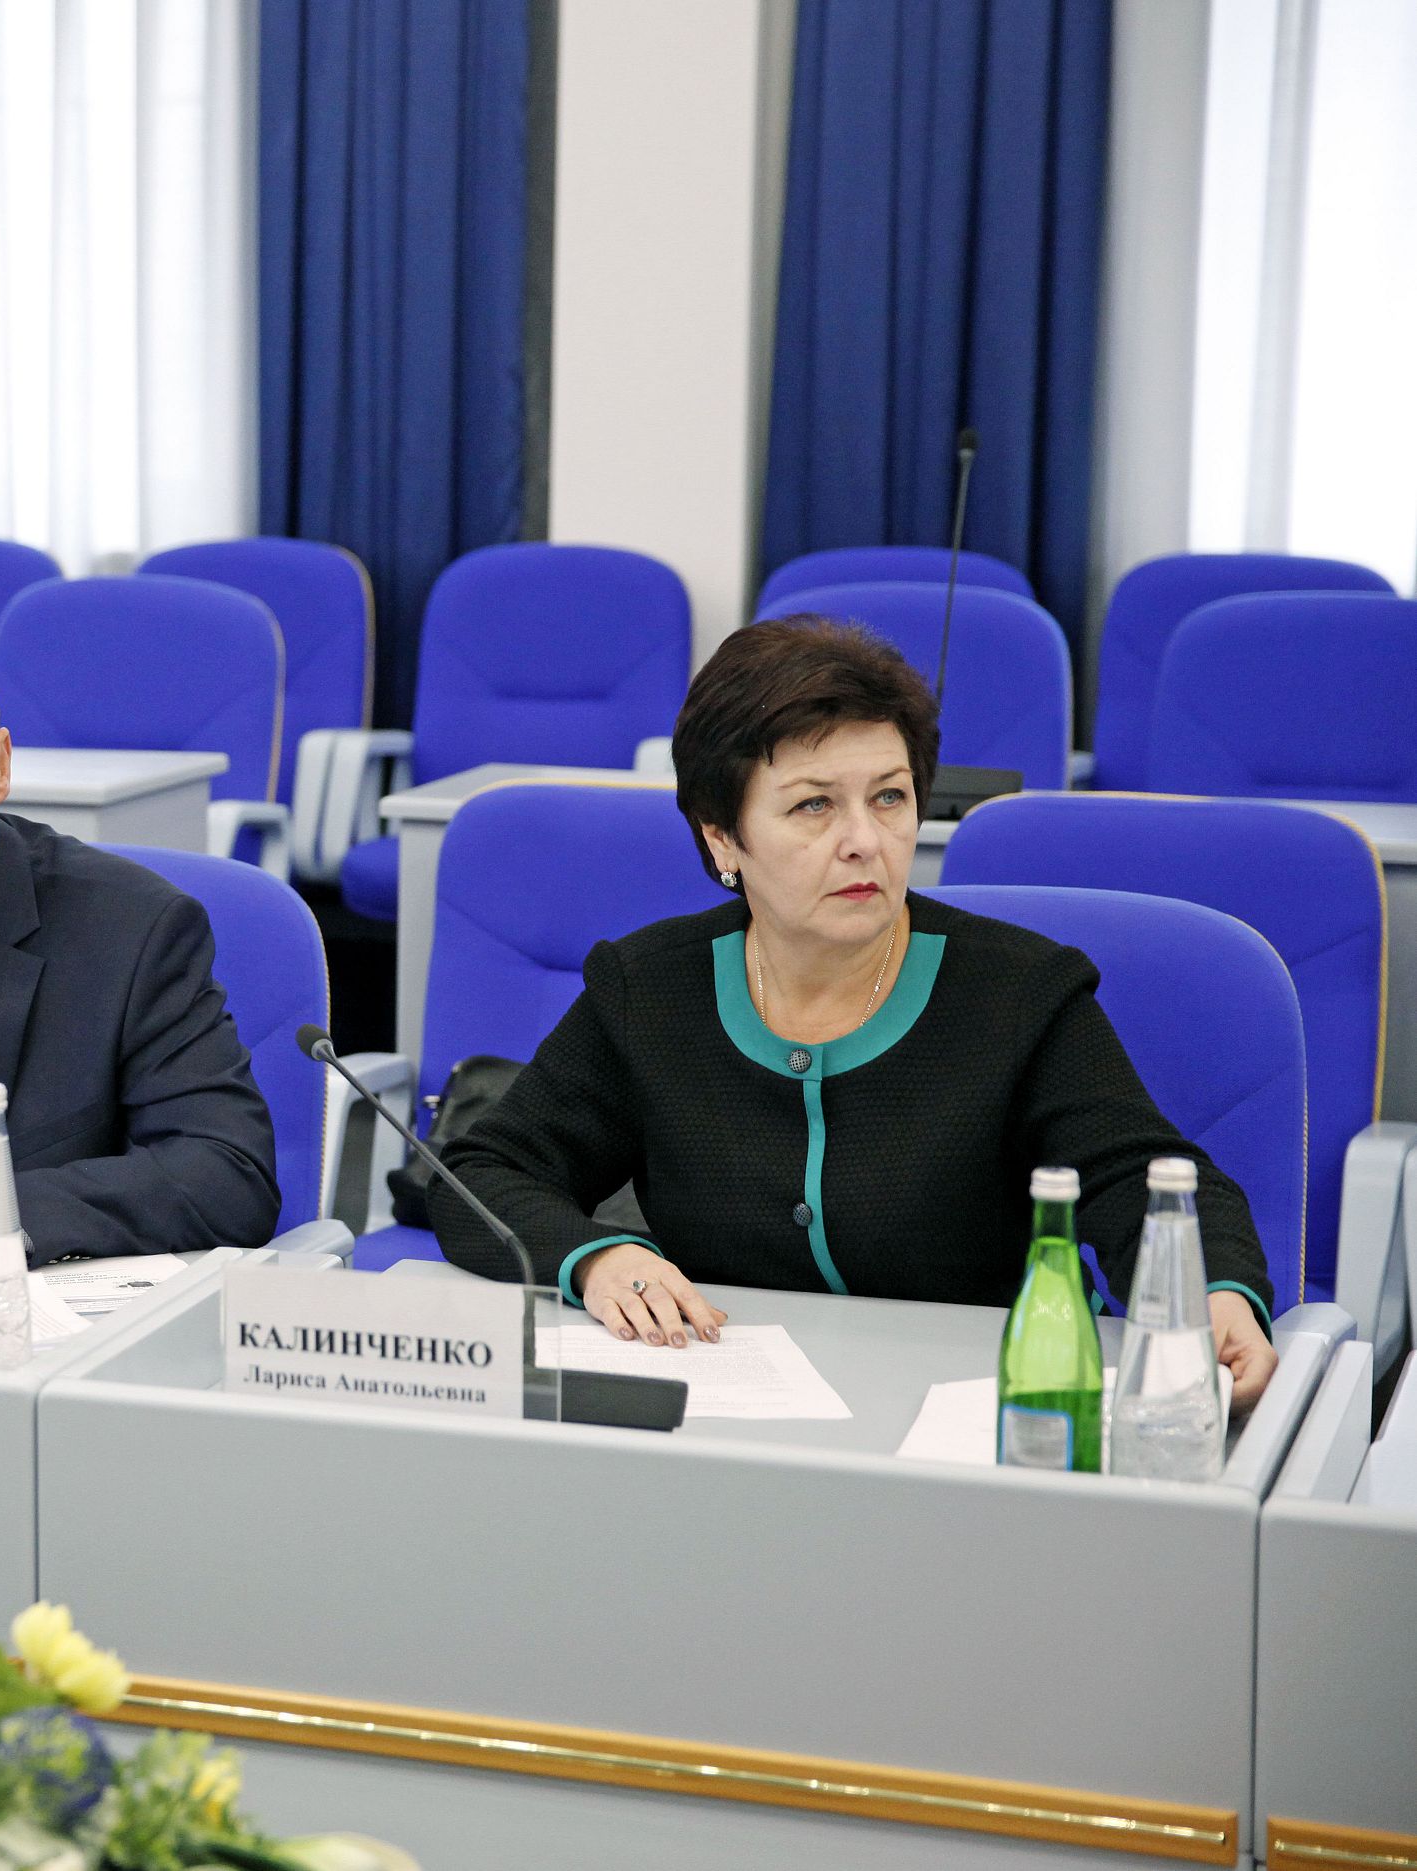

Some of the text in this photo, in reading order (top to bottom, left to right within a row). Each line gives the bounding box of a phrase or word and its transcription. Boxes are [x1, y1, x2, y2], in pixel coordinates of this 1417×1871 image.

[238, 1321, 493, 1369] КАЛИНЧЕНКО
[243, 1364, 486, 1403] Лариса Анатольевна
